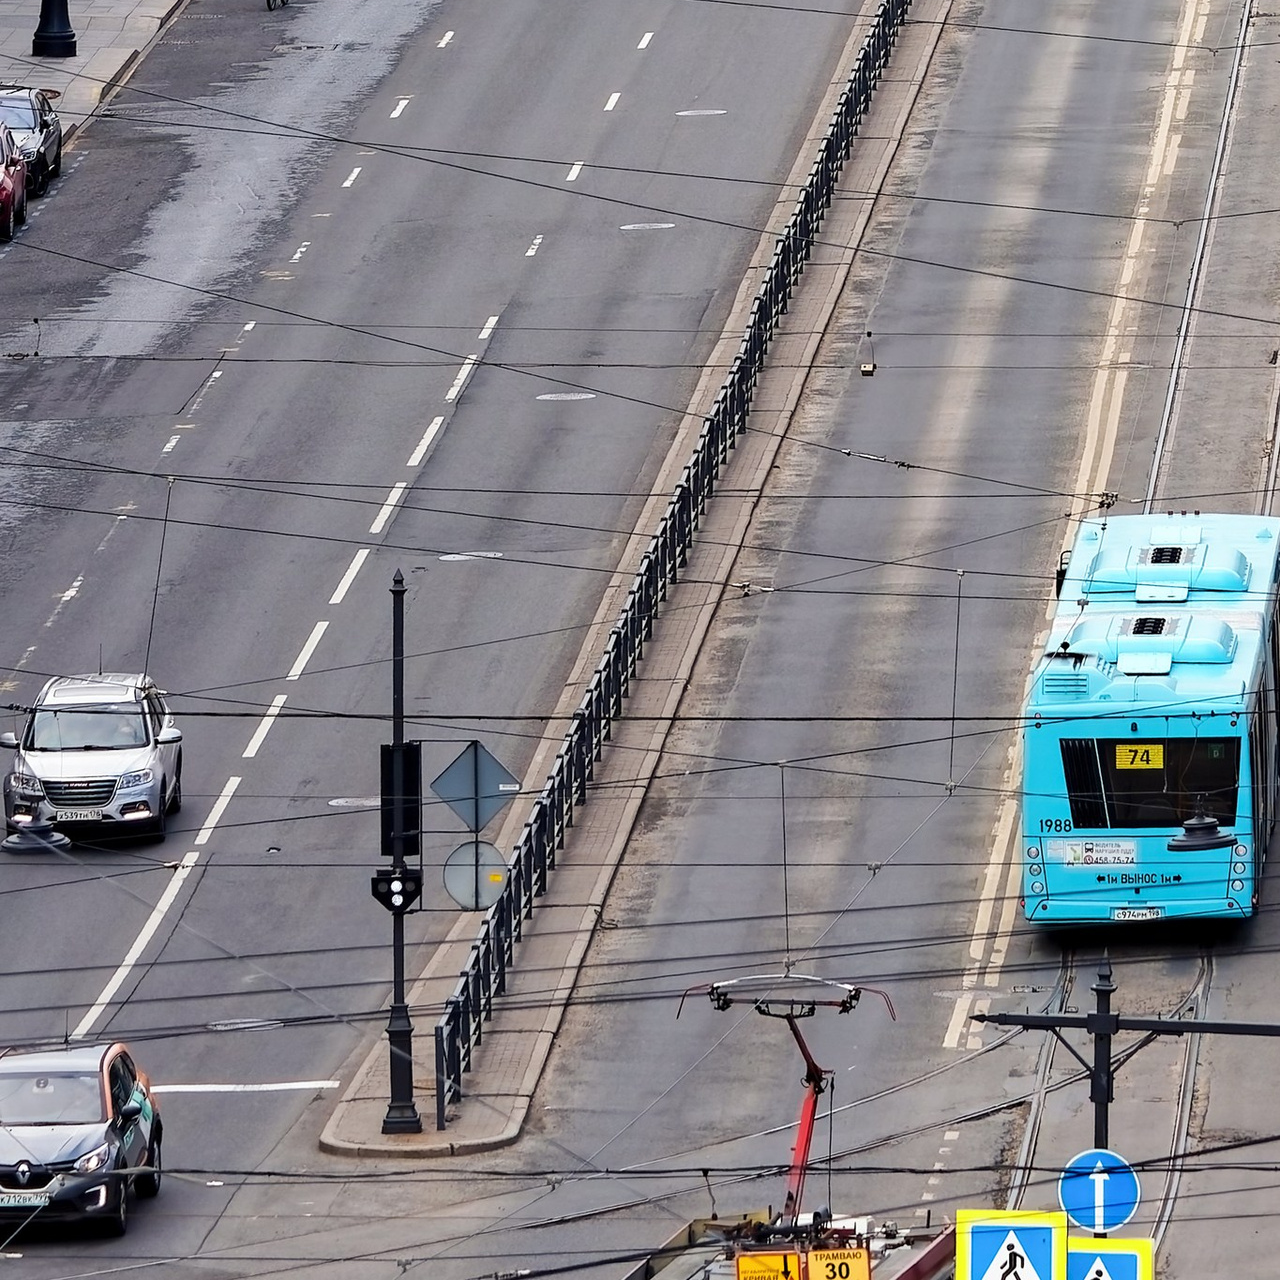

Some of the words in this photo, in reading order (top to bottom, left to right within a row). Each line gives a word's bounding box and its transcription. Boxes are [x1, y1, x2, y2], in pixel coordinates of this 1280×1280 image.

[1128, 748, 1151, 765] 74
[1039, 819, 1072, 833] 1988
[1106, 874, 1118, 884] 1м
[1121, 873, 1157, 884] ВЫНОС
[1161, 873, 1172, 884] 1м
[813, 1251, 862, 1262] ТРАМВАЮ
[825, 1262, 850, 1280] 30
